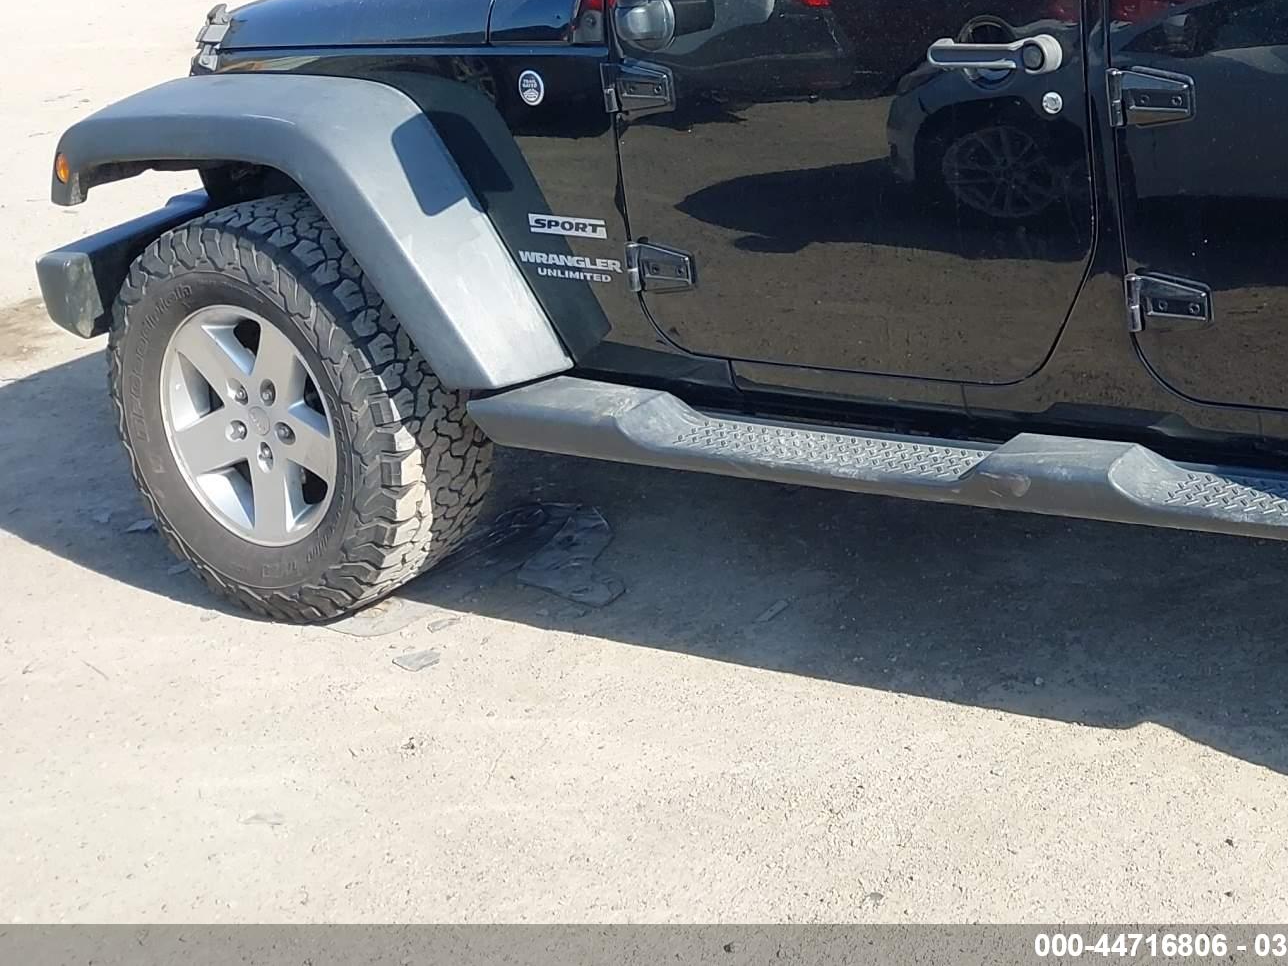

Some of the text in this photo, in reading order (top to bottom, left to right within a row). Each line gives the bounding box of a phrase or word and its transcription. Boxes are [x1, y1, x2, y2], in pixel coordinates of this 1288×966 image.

[531, 218, 606, 234] SPORT
[518, 250, 623, 274] WRANGLER
[537, 267, 612, 283] UNLIMITED
